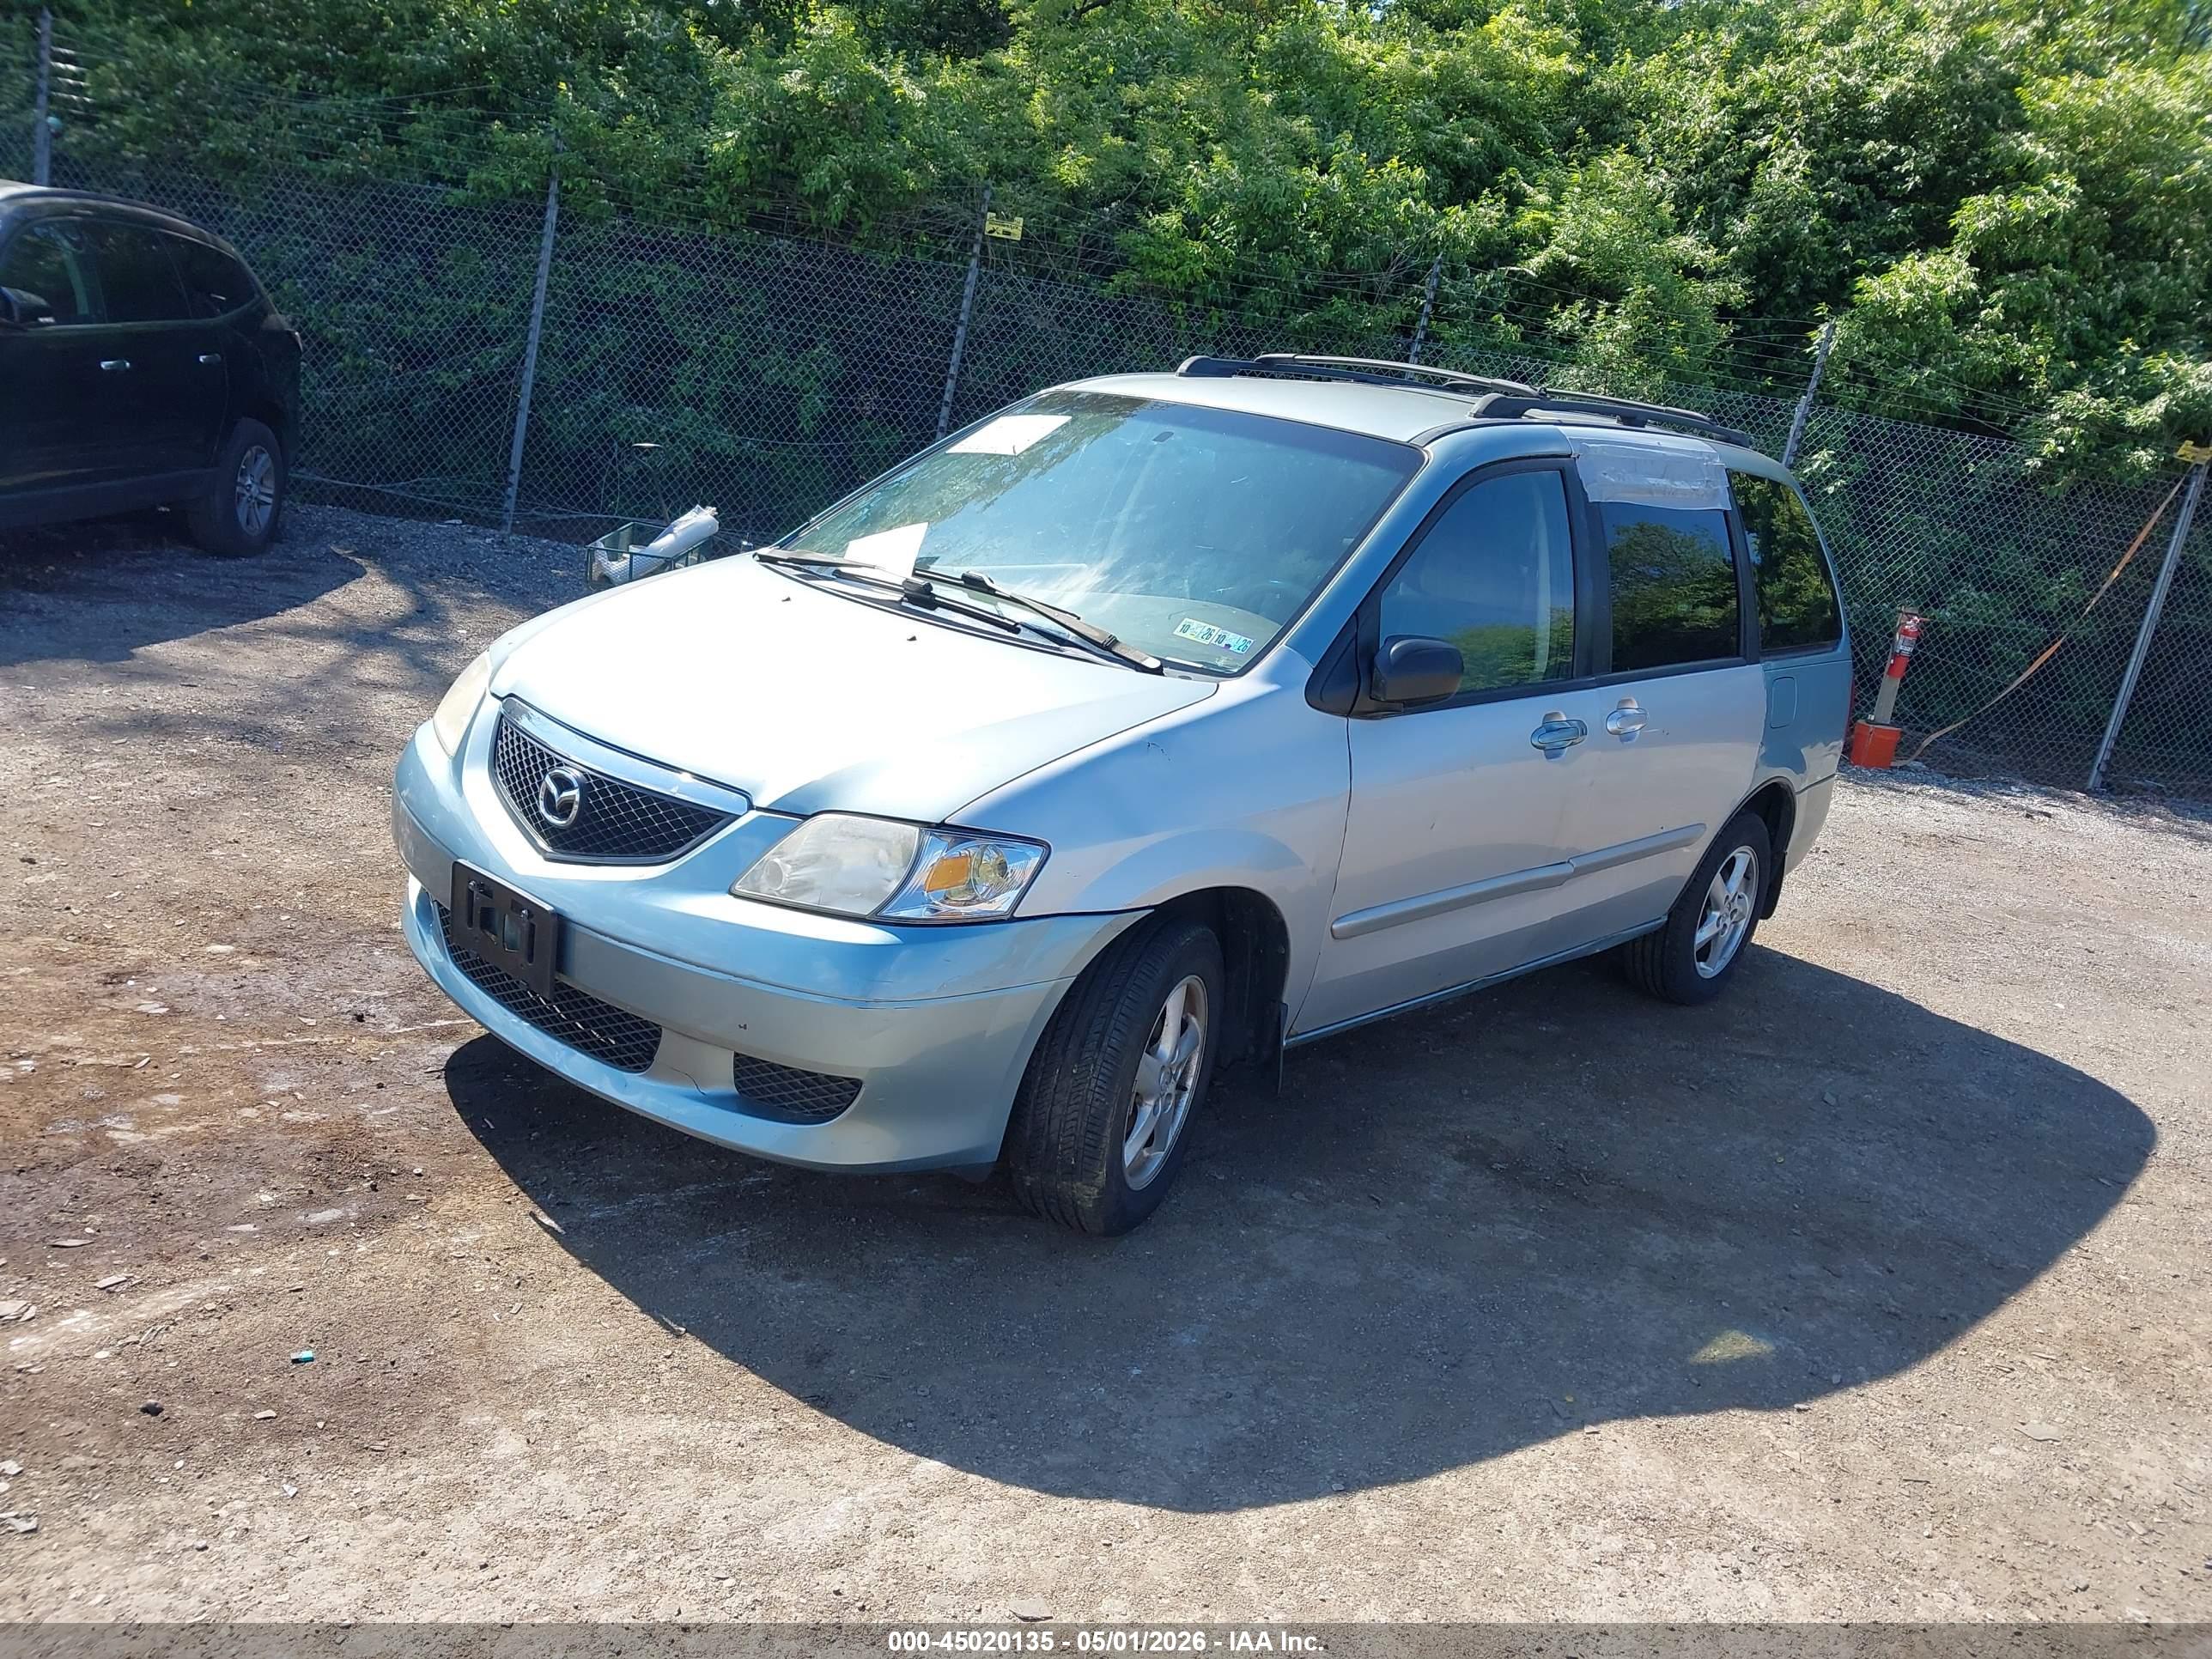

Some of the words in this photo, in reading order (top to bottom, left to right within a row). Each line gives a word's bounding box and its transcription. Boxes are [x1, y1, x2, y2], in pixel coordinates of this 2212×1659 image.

[1179, 623, 1191, 634] 10
[1200, 627, 1216, 641] 26
[1214, 634, 1227, 645] 10
[1237, 638, 1252, 653] 26
